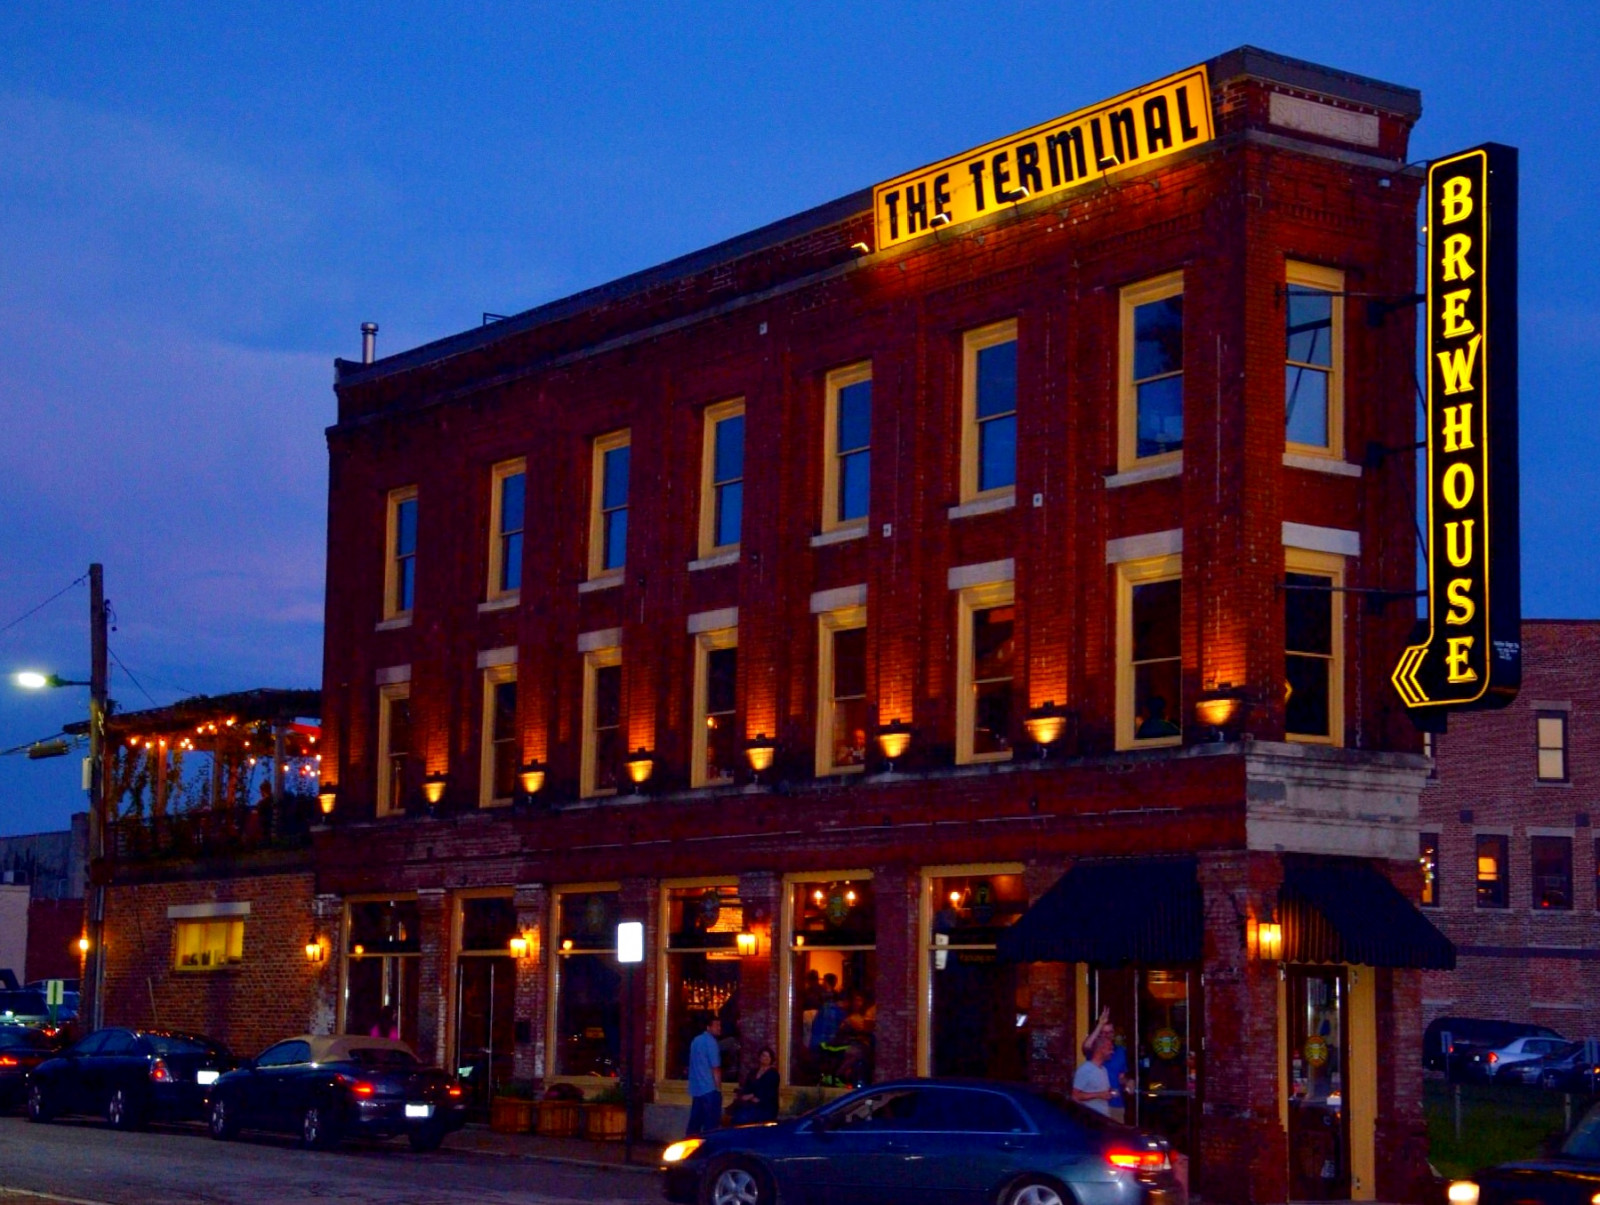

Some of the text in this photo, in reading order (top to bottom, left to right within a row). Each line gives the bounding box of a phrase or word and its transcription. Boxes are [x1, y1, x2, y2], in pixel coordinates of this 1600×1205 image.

[884, 172, 953, 241] THE
[968, 85, 1199, 212] TERMINAL
[1436, 176, 1482, 684] BREWHOUSE
